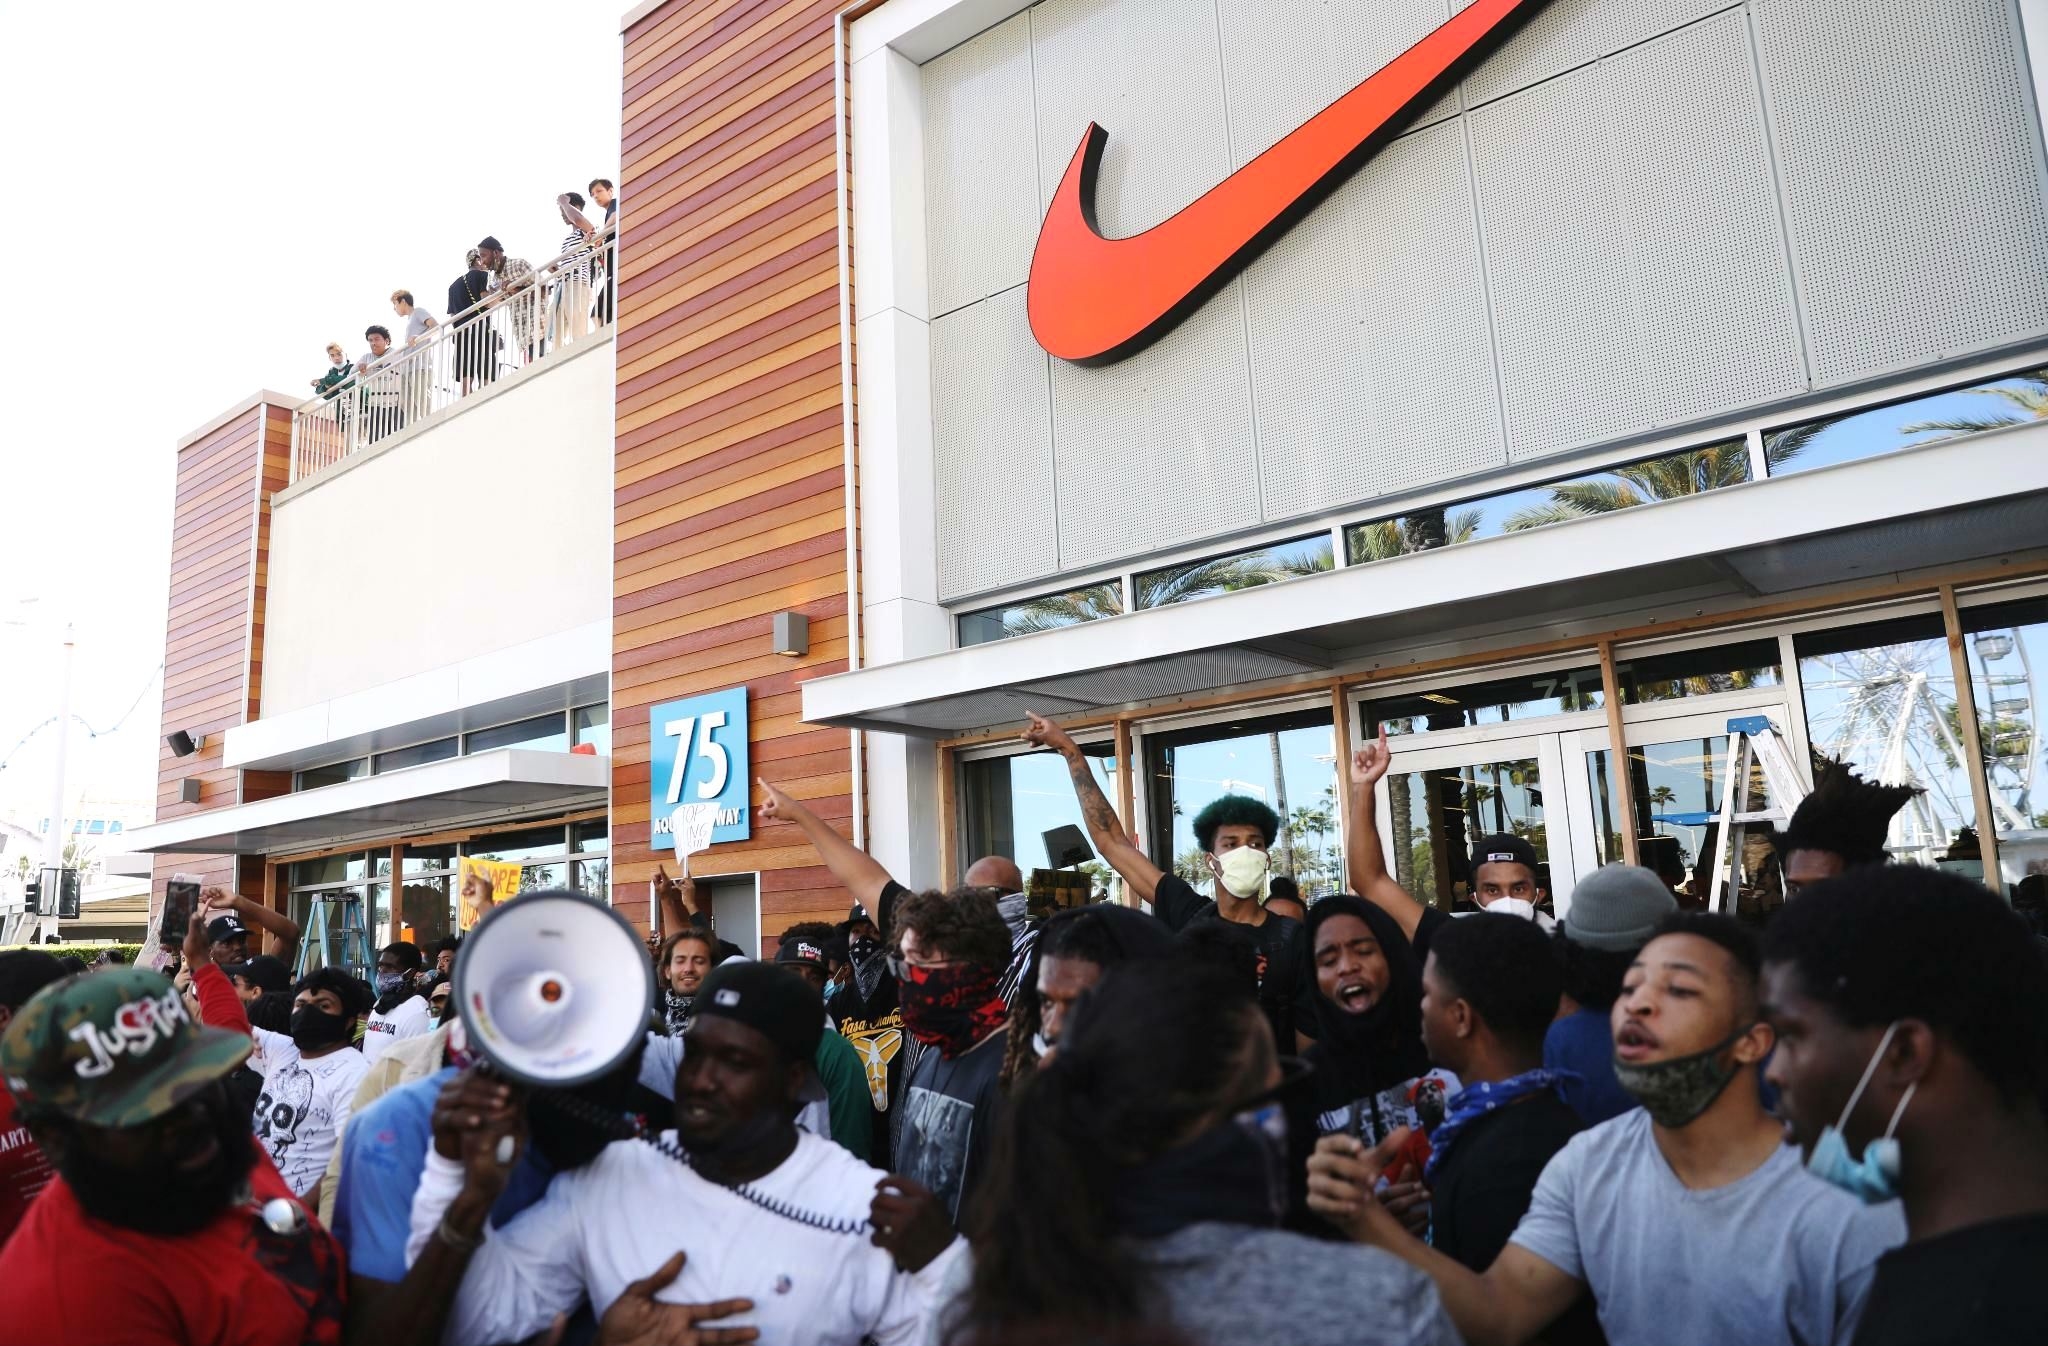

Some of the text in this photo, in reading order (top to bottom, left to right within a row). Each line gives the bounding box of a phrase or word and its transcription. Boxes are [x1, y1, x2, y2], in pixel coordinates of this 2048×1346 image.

[665, 711, 728, 804] 75
[714, 808, 741, 828] WAY
[225, 917, 238, 927] LA
